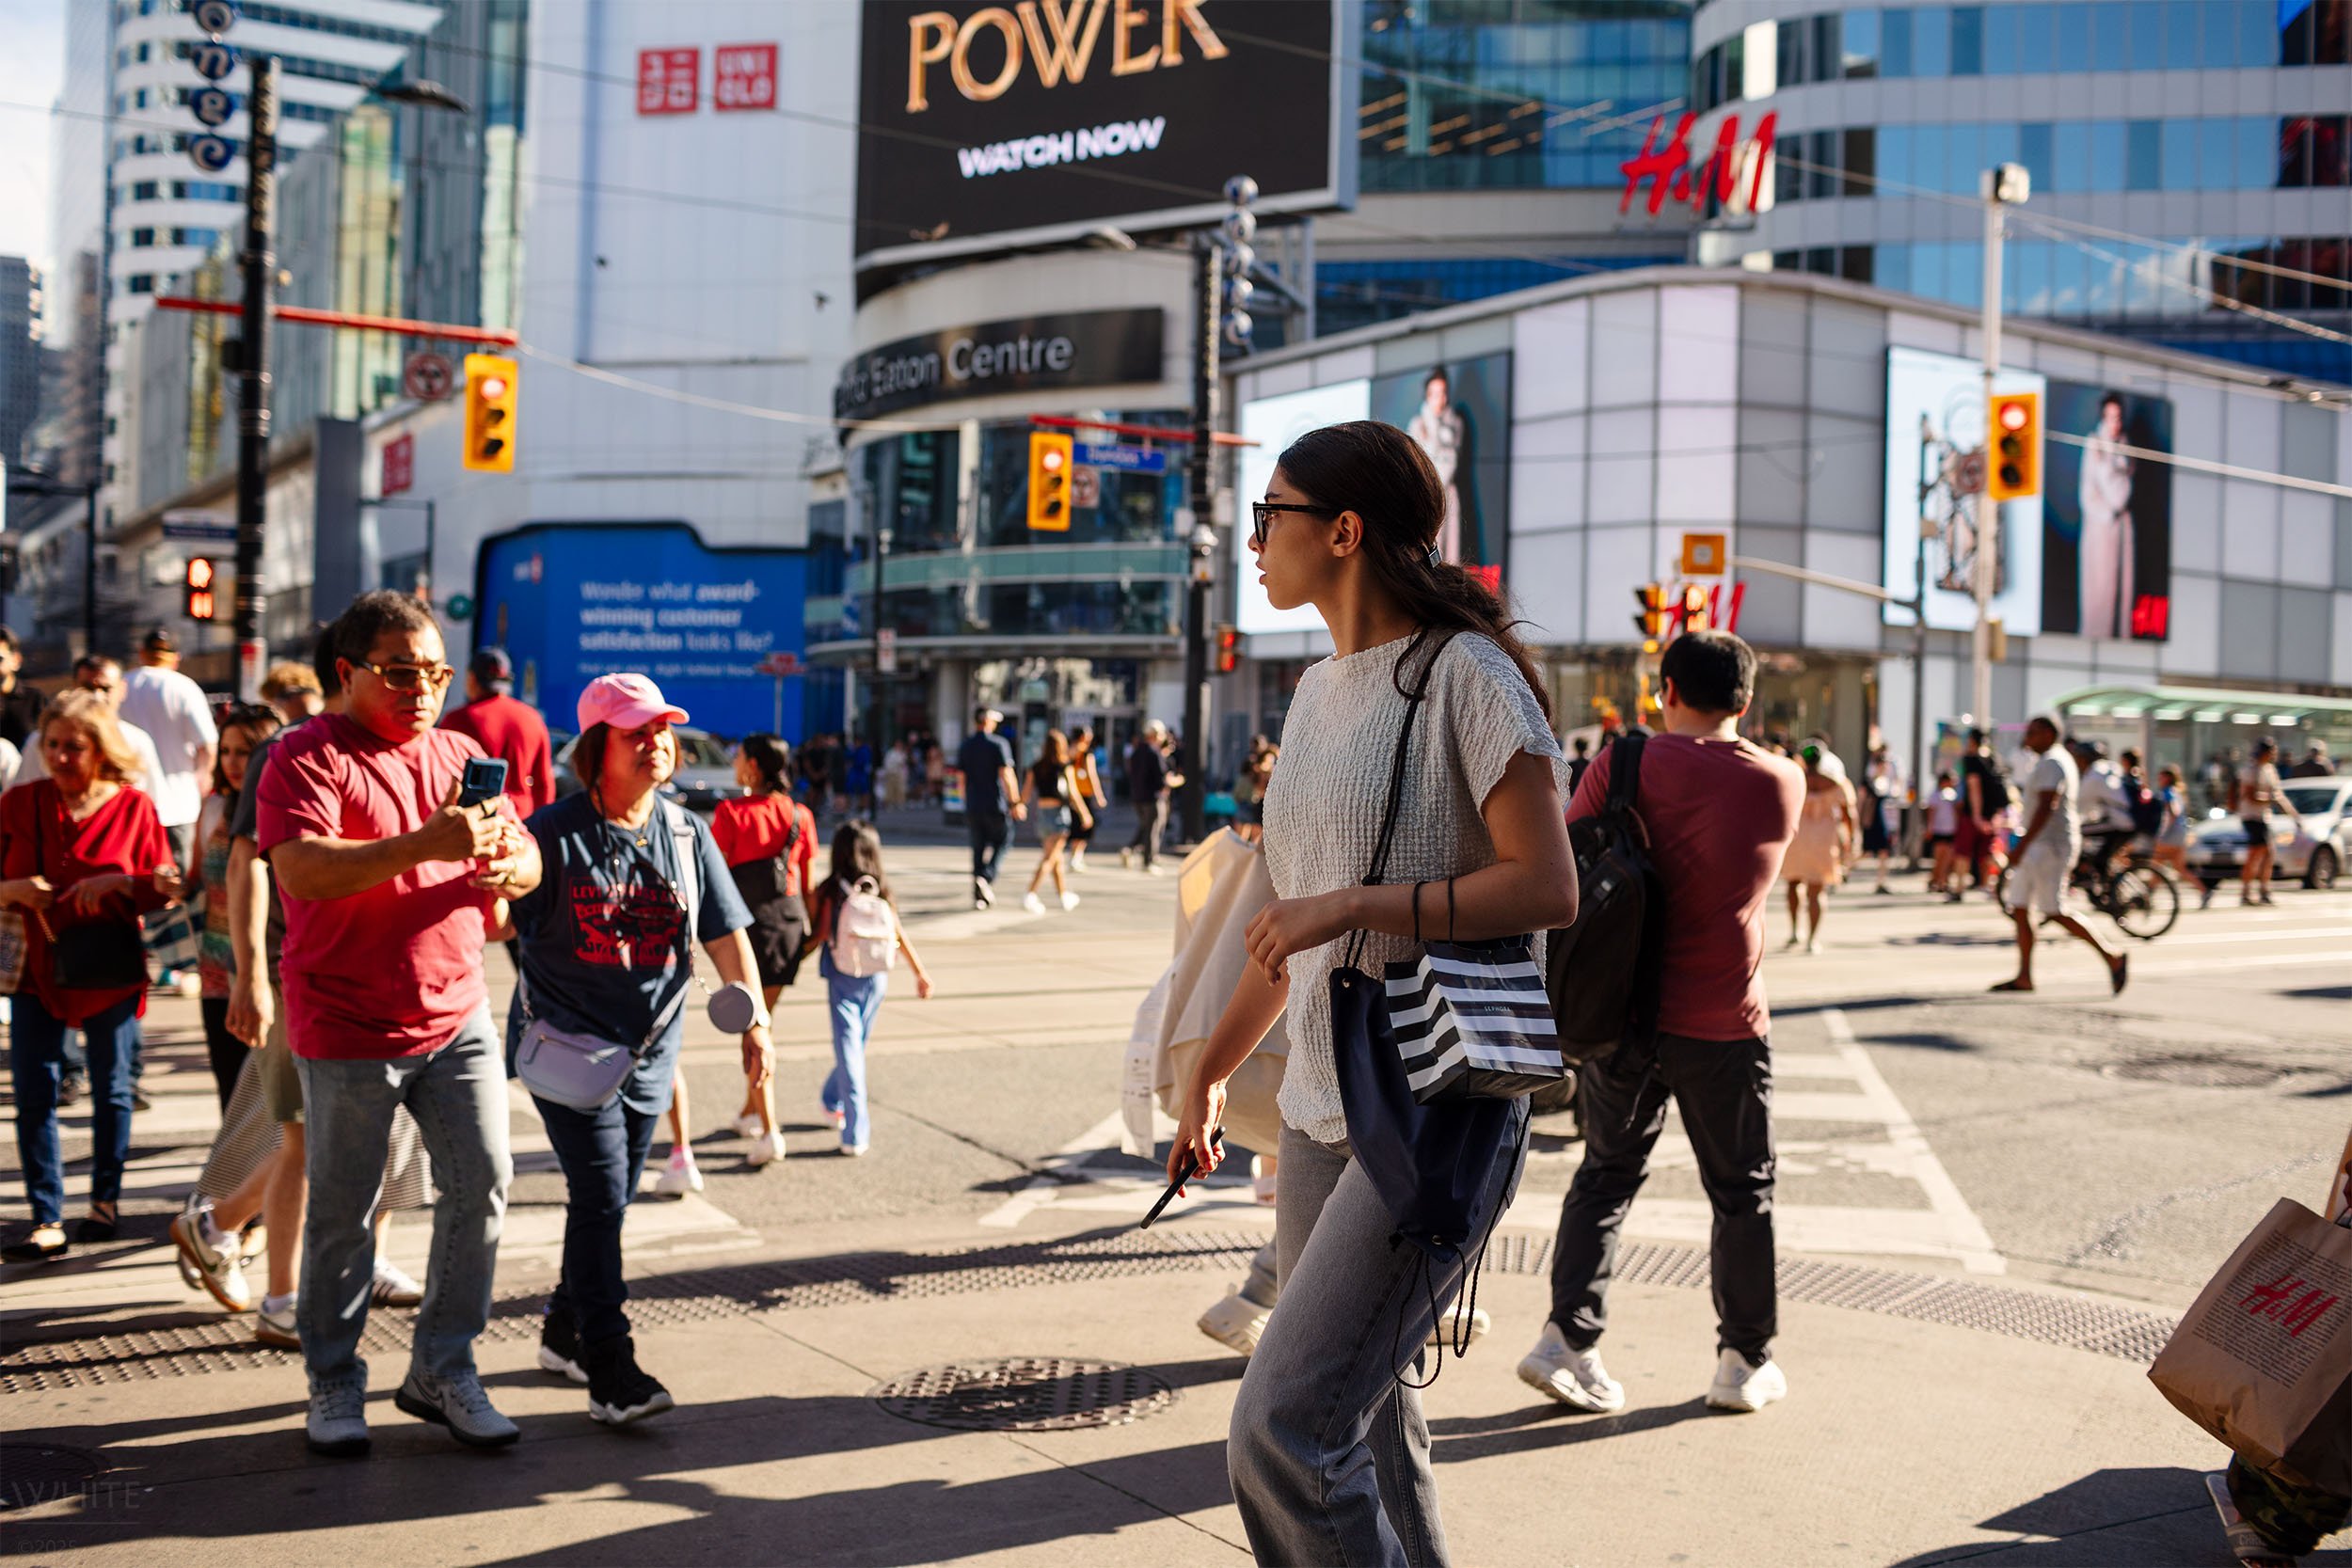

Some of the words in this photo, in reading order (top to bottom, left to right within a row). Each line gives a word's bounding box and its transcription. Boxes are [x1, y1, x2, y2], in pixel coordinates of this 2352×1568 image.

[719, 50, 769, 76] UNI
[906, 0, 1230, 113] POWER
[958, 130, 1074, 179] WATCH
[1076, 116, 1166, 161] NOW
[1619, 110, 1777, 216] H&M
[871, 352, 941, 397] Eaton
[947, 336, 1074, 380] Centre
[580, 607, 654, 630] winning
[658, 608, 741, 626] customer
[648, 580, 692, 601] what
[695, 578, 760, 602] award-
[580, 630, 682, 651] satisfaction
[2238, 1274, 2341, 1338] H&M
